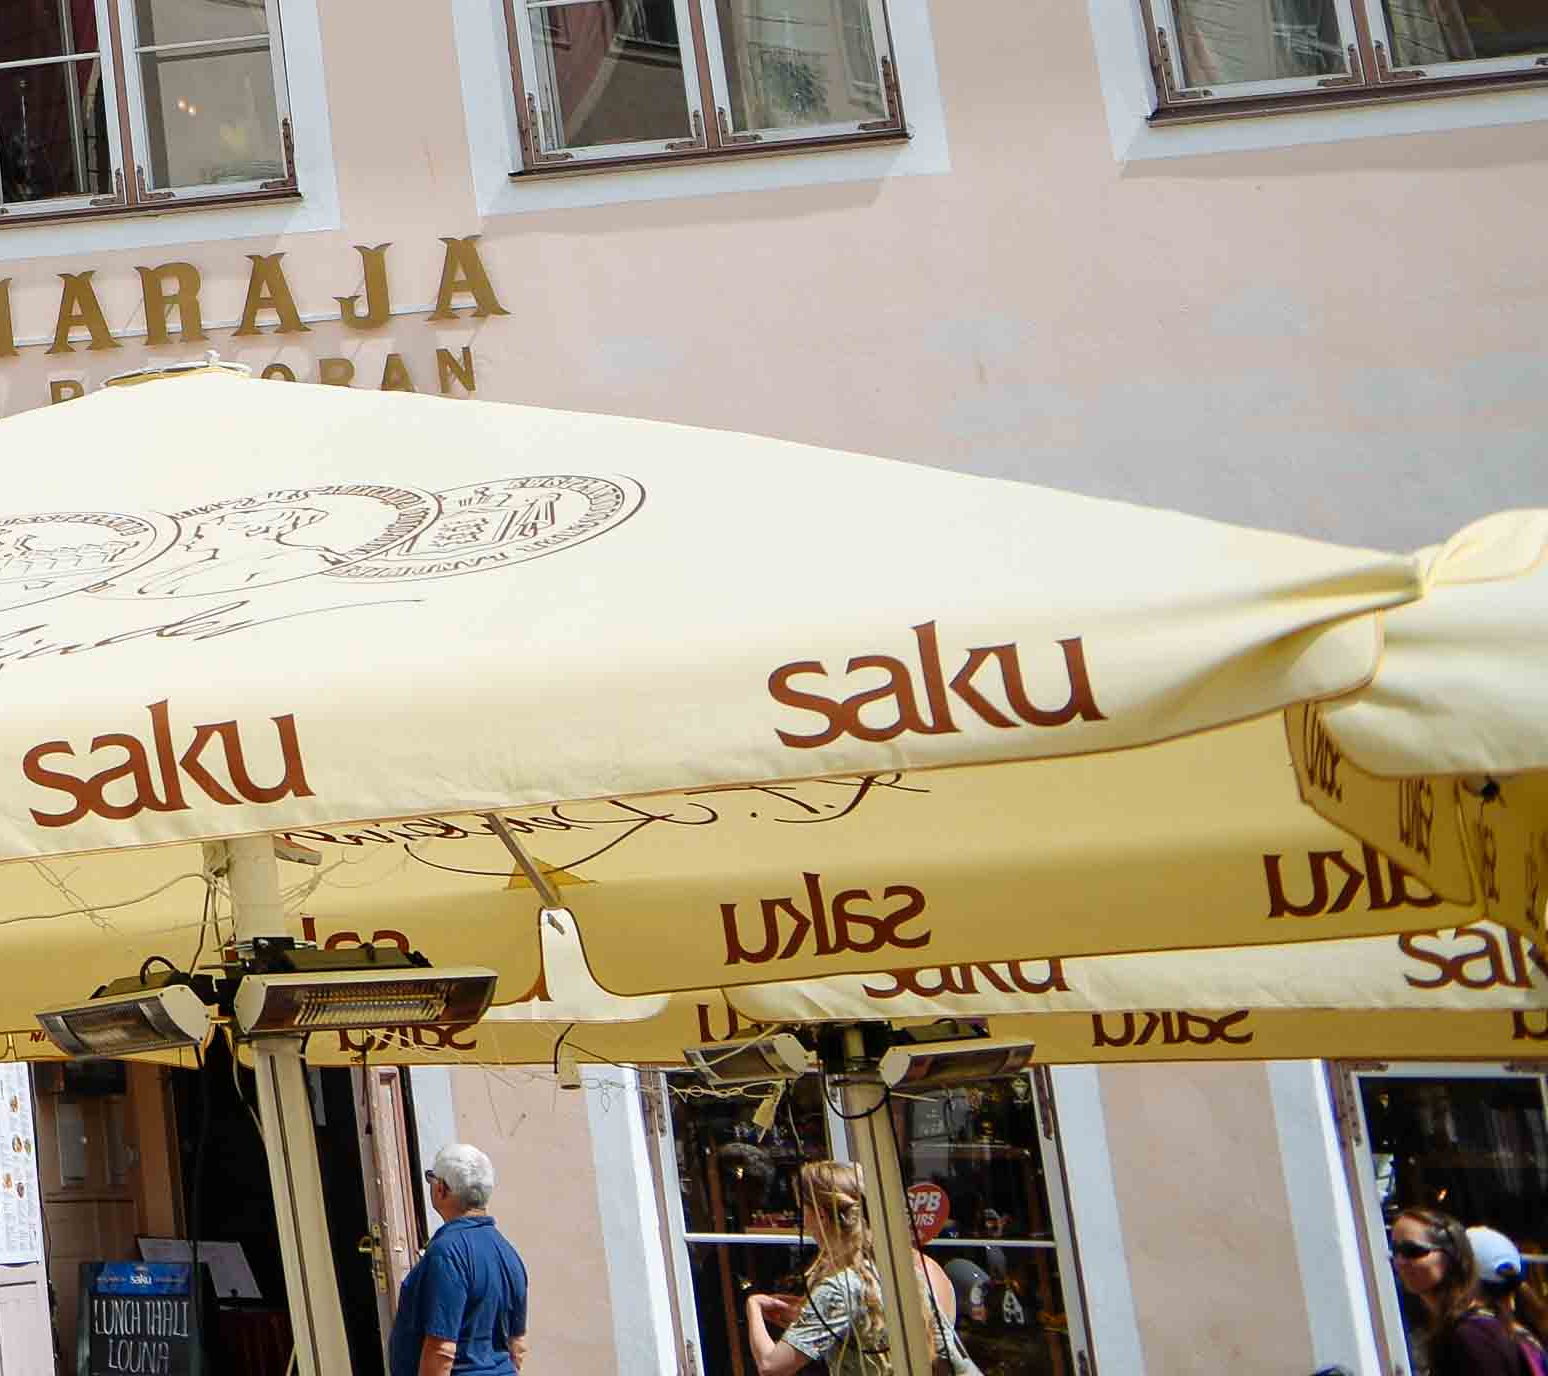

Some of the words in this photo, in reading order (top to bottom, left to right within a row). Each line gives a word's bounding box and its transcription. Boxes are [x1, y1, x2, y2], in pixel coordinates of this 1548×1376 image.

[768, 621, 1108, 748] saku
[23, 699, 315, 827] saku
[129, 1273, 153, 1286] saku
[93, 1299, 141, 1336] LUNCH
[145, 1299, 189, 1337] THALI
[108, 1338, 170, 1374] LOUNA
